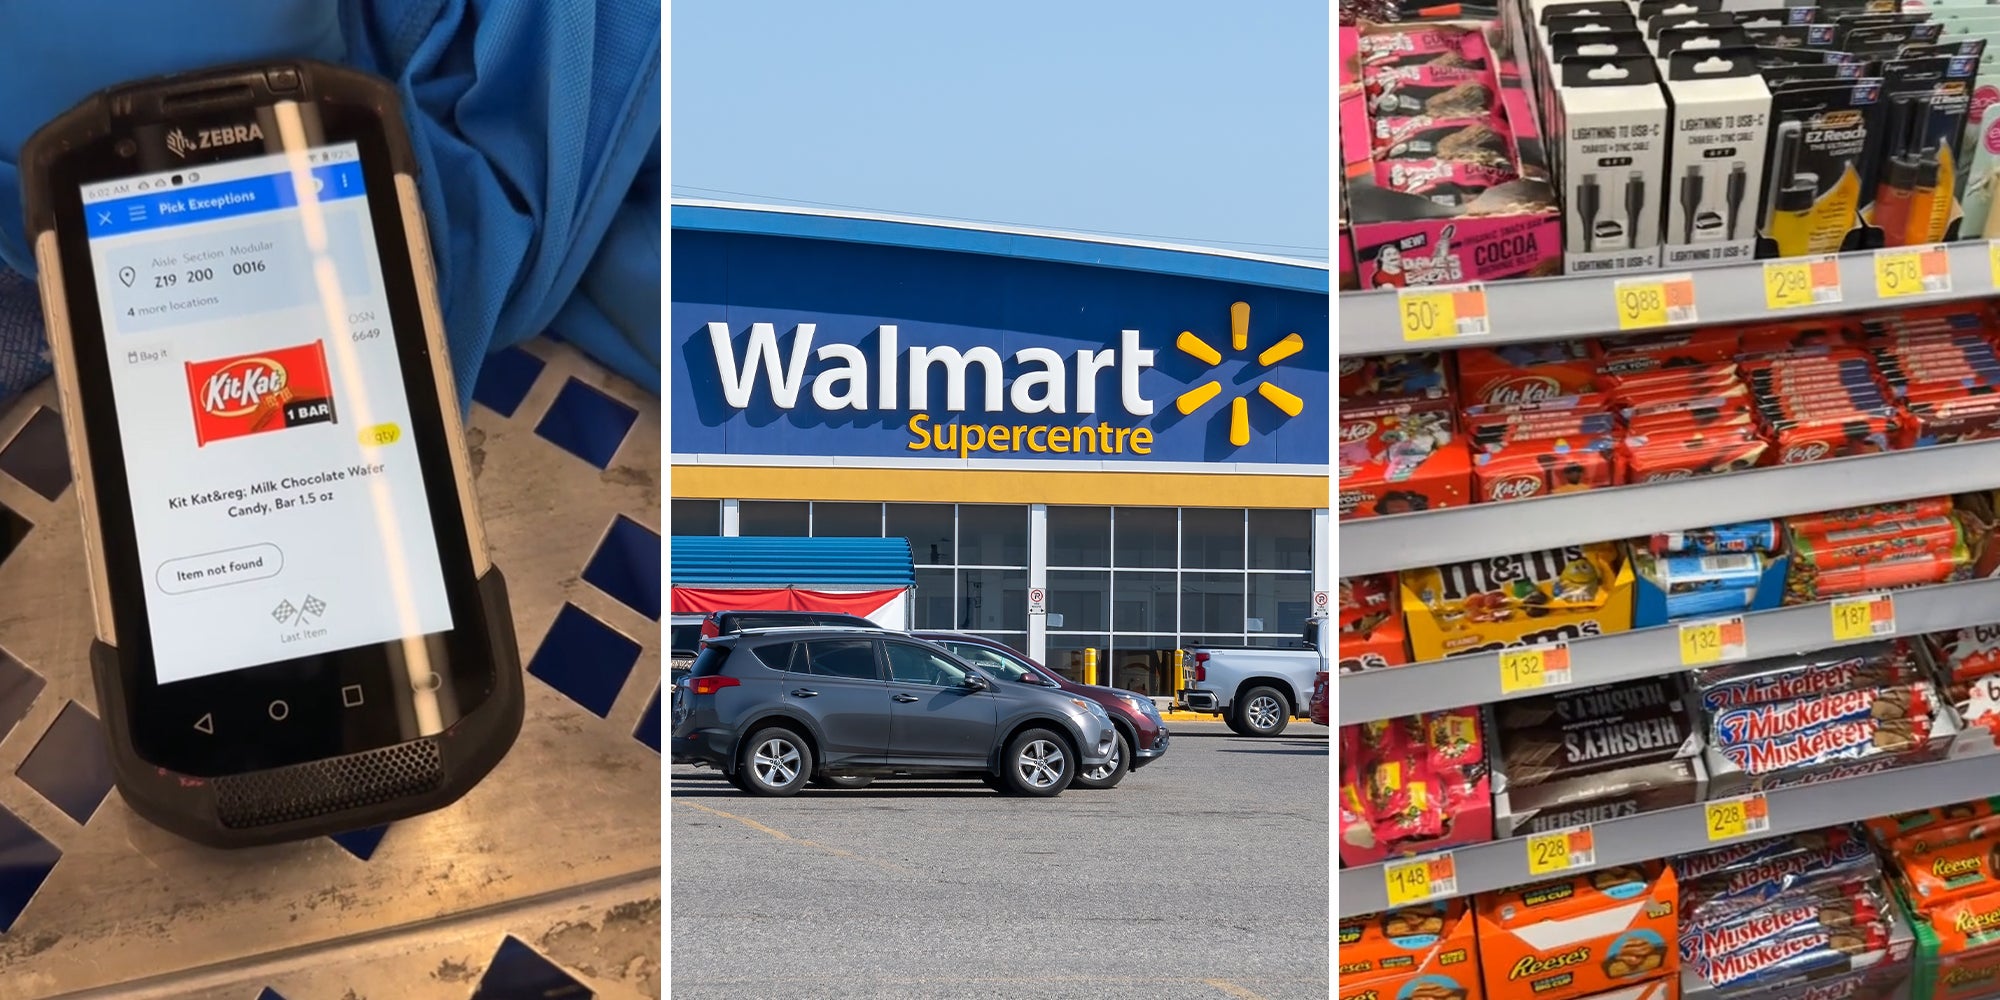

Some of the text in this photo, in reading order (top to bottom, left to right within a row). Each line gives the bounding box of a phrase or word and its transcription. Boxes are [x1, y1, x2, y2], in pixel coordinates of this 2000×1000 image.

[1572, 123, 1660, 140] LIGHTNING TO USB-C
[1680, 114, 1765, 132] LIGHTNING TO USB-C
[1805, 126, 1867, 144] EZ Reach
[198, 123, 264, 149] ZEBRA
[88, 184, 130, 199] 6:02 AM
[159, 190, 256, 215] Pick Exceptions
[152, 241, 275, 268] Aisle Section Modular
[1400, 234, 1427, 250] NEW!
[1474, 232, 1538, 267] COCOA
[1670, 245, 1749, 262] LIGHTNING TO USB-C
[154, 260, 266, 289] Z19 200 0016
[1573, 255, 1652, 271] LIGHTNING TO USB-C
[127, 295, 219, 317] 4 more locations
[348, 311, 375, 325] OSN
[351, 328, 381, 342] 6649
[140, 348, 168, 363] Bag it
[1597, 360, 1661, 373] BLACK YOUTH
[708, 321, 1155, 417] Walmart
[287, 403, 328, 420] 1 BAR
[375, 429, 395, 443] qty
[908, 413, 1154, 459] Supercentre
[169, 464, 385, 509] Kit Kat&reg; Milk Chocolate Wafer
[228, 491, 334, 517] Candy, Bar 1.5 oz
[177, 557, 263, 582] Item not found
[280, 627, 327, 644] Last Item
[1730, 657, 1864, 706] Musketeers
[1555, 682, 1665, 719] HERSHEY'S
[1725, 686, 1879, 743] 3 Musketeers
[1565, 715, 1680, 763] HERSHEY'S
[1749, 718, 1879, 775] Musketeers
[1532, 799, 1637, 833] HERSHEY'S
[1525, 888, 1573, 905] BIG CUP
[1703, 902, 1819, 958] Musketeer
[1509, 946, 1591, 980] Reese's
[1711, 931, 1829, 984] Musketeer
